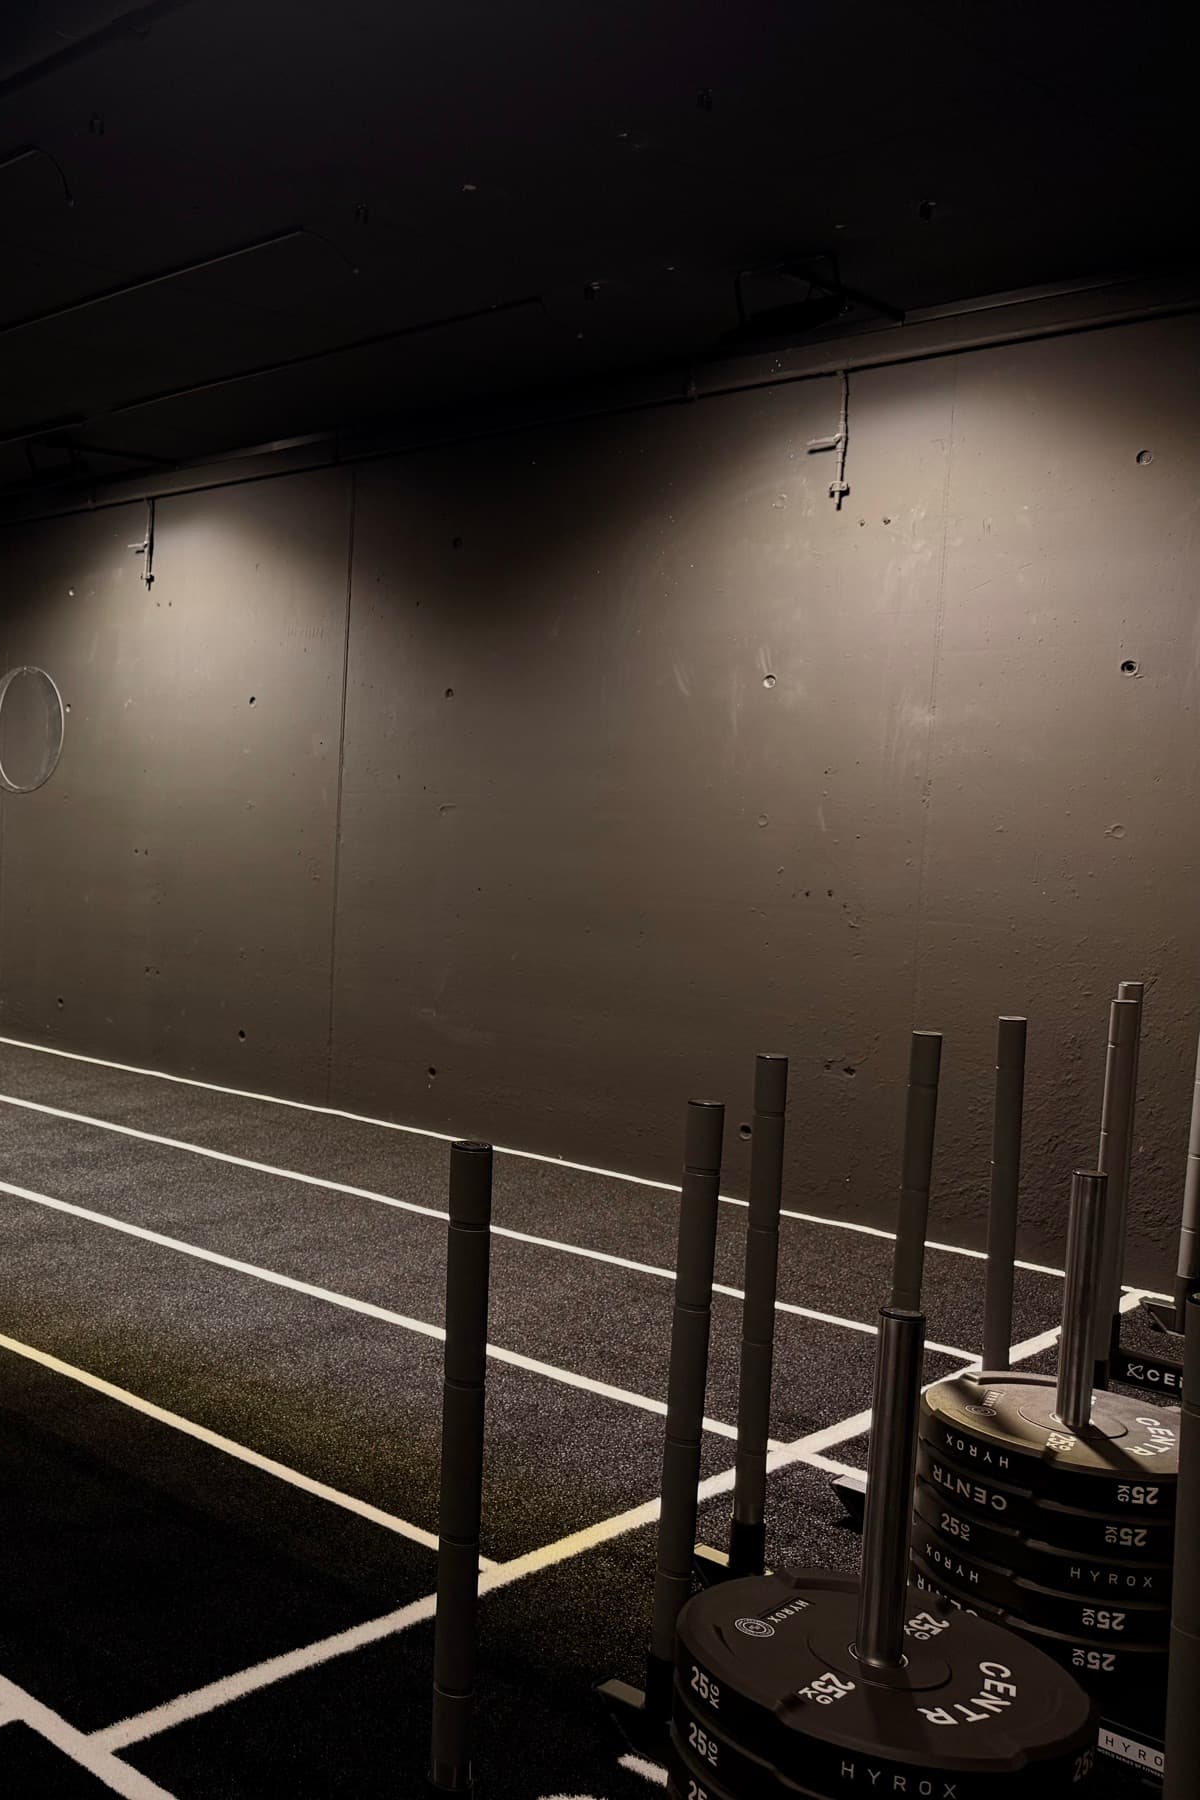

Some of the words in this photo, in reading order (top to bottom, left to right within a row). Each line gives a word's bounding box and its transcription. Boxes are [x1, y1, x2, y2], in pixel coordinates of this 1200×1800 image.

[946, 1433, 1009, 1469] HYROX
[1124, 1417, 1176, 1455] CENTR
[933, 1465, 1007, 1511] CENTR
[926, 1544, 978, 1583] HYROX
[1070, 1567, 1152, 1588] HYROX
[767, 1599, 810, 1623] HYROX
[916, 1661, 1016, 1725] CENTR
[1105, 1736, 1164, 1767] HYRO
[841, 1760, 957, 1799] HYROX
